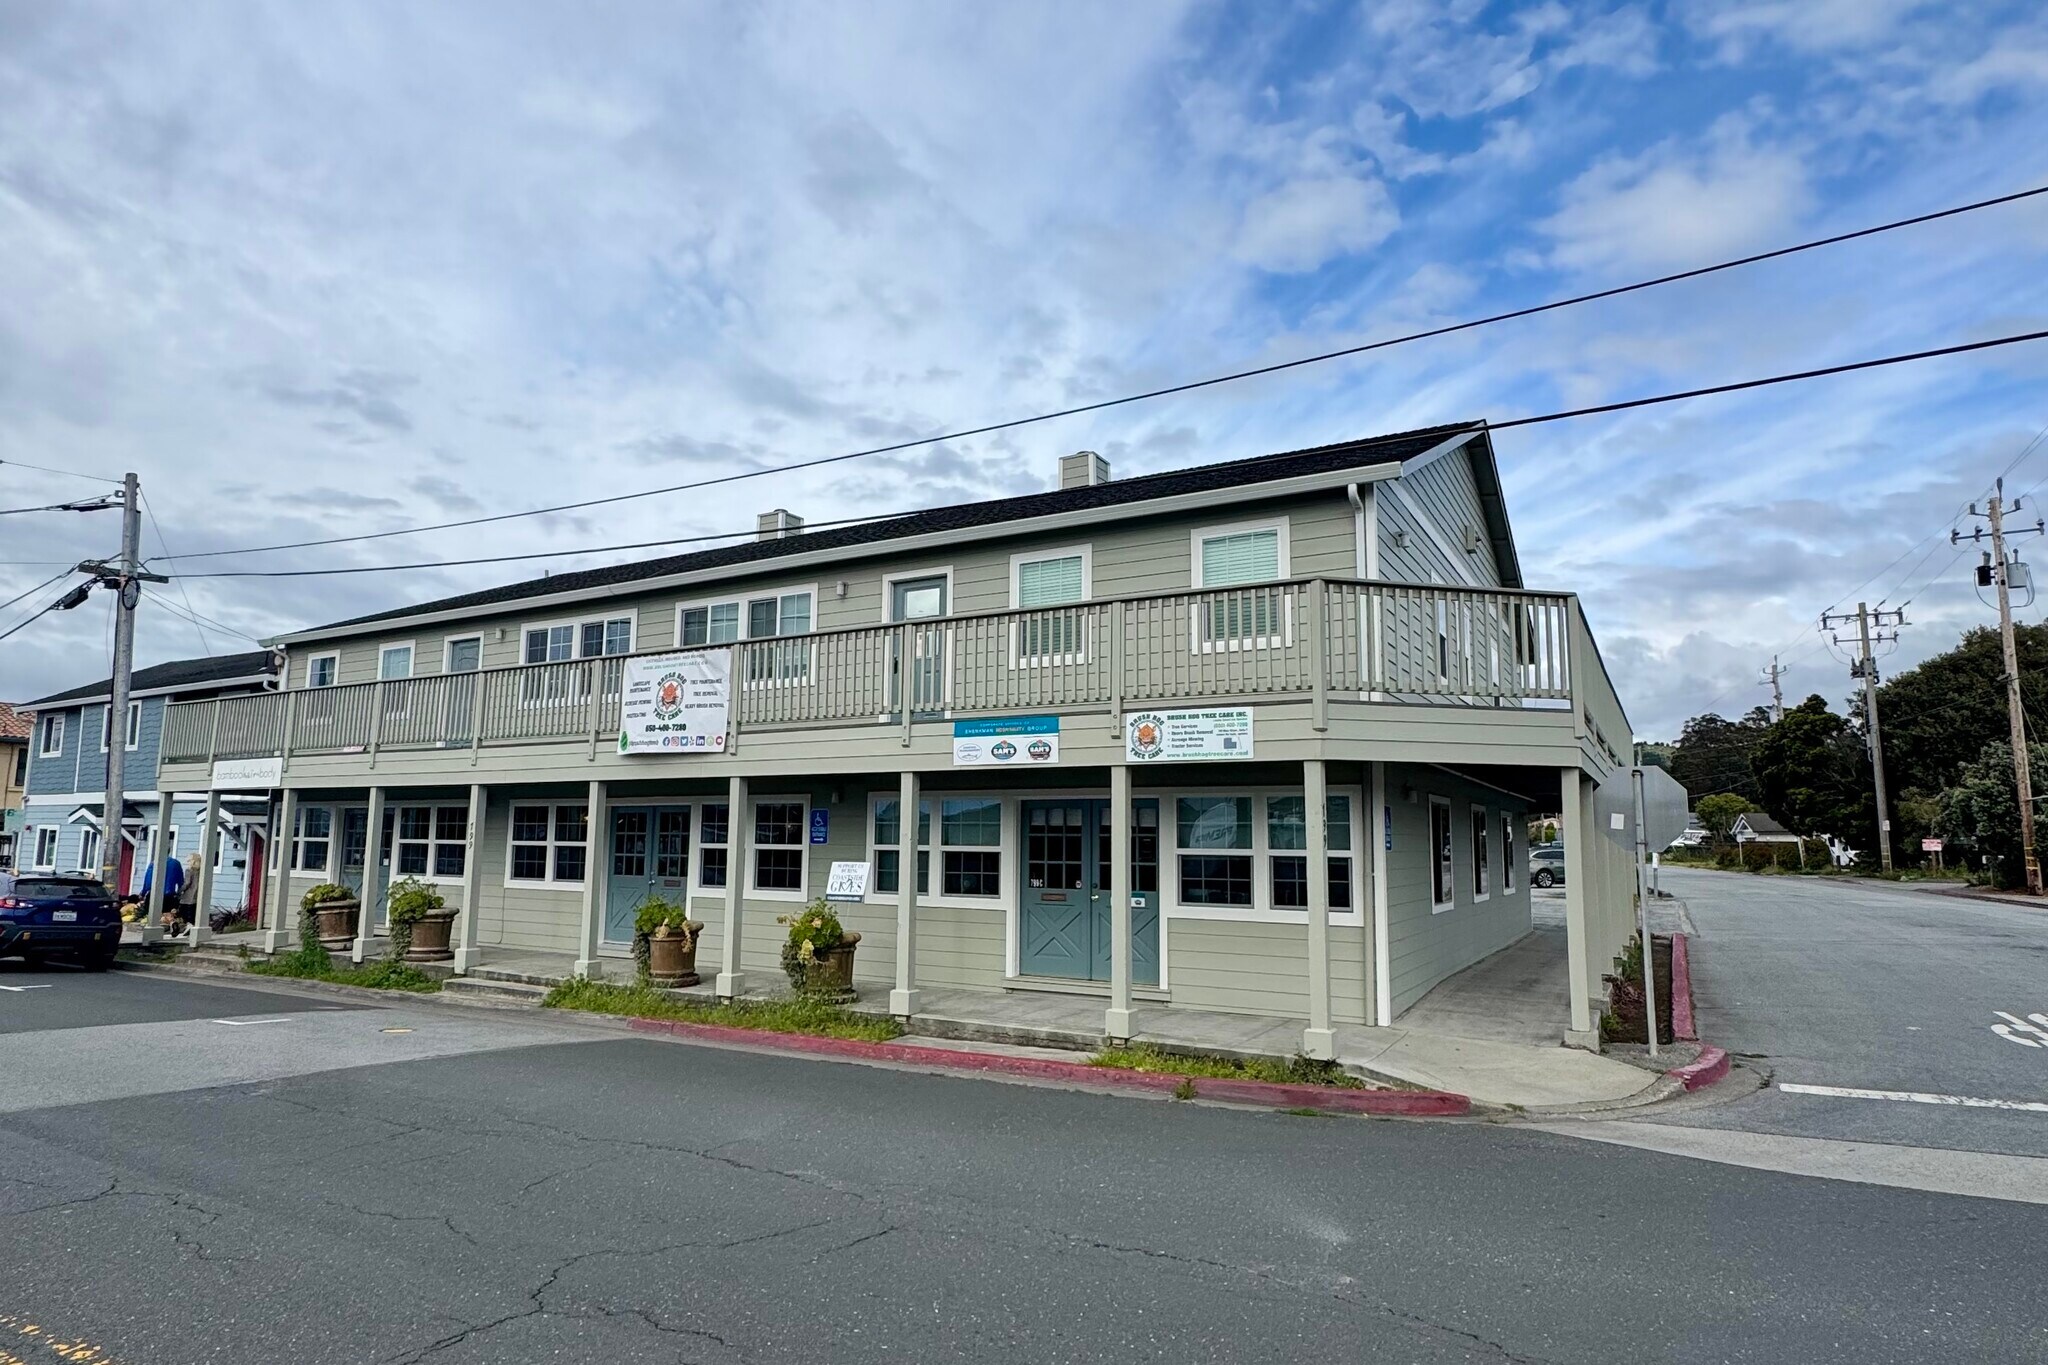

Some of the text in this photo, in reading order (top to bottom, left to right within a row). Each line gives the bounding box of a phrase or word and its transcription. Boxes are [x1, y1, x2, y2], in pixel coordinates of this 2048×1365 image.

[653, 707, 683, 720] TREE CARE
[1129, 713, 1165, 728] BRUSH HOG
[1130, 746, 1164, 759] TREE CARE
